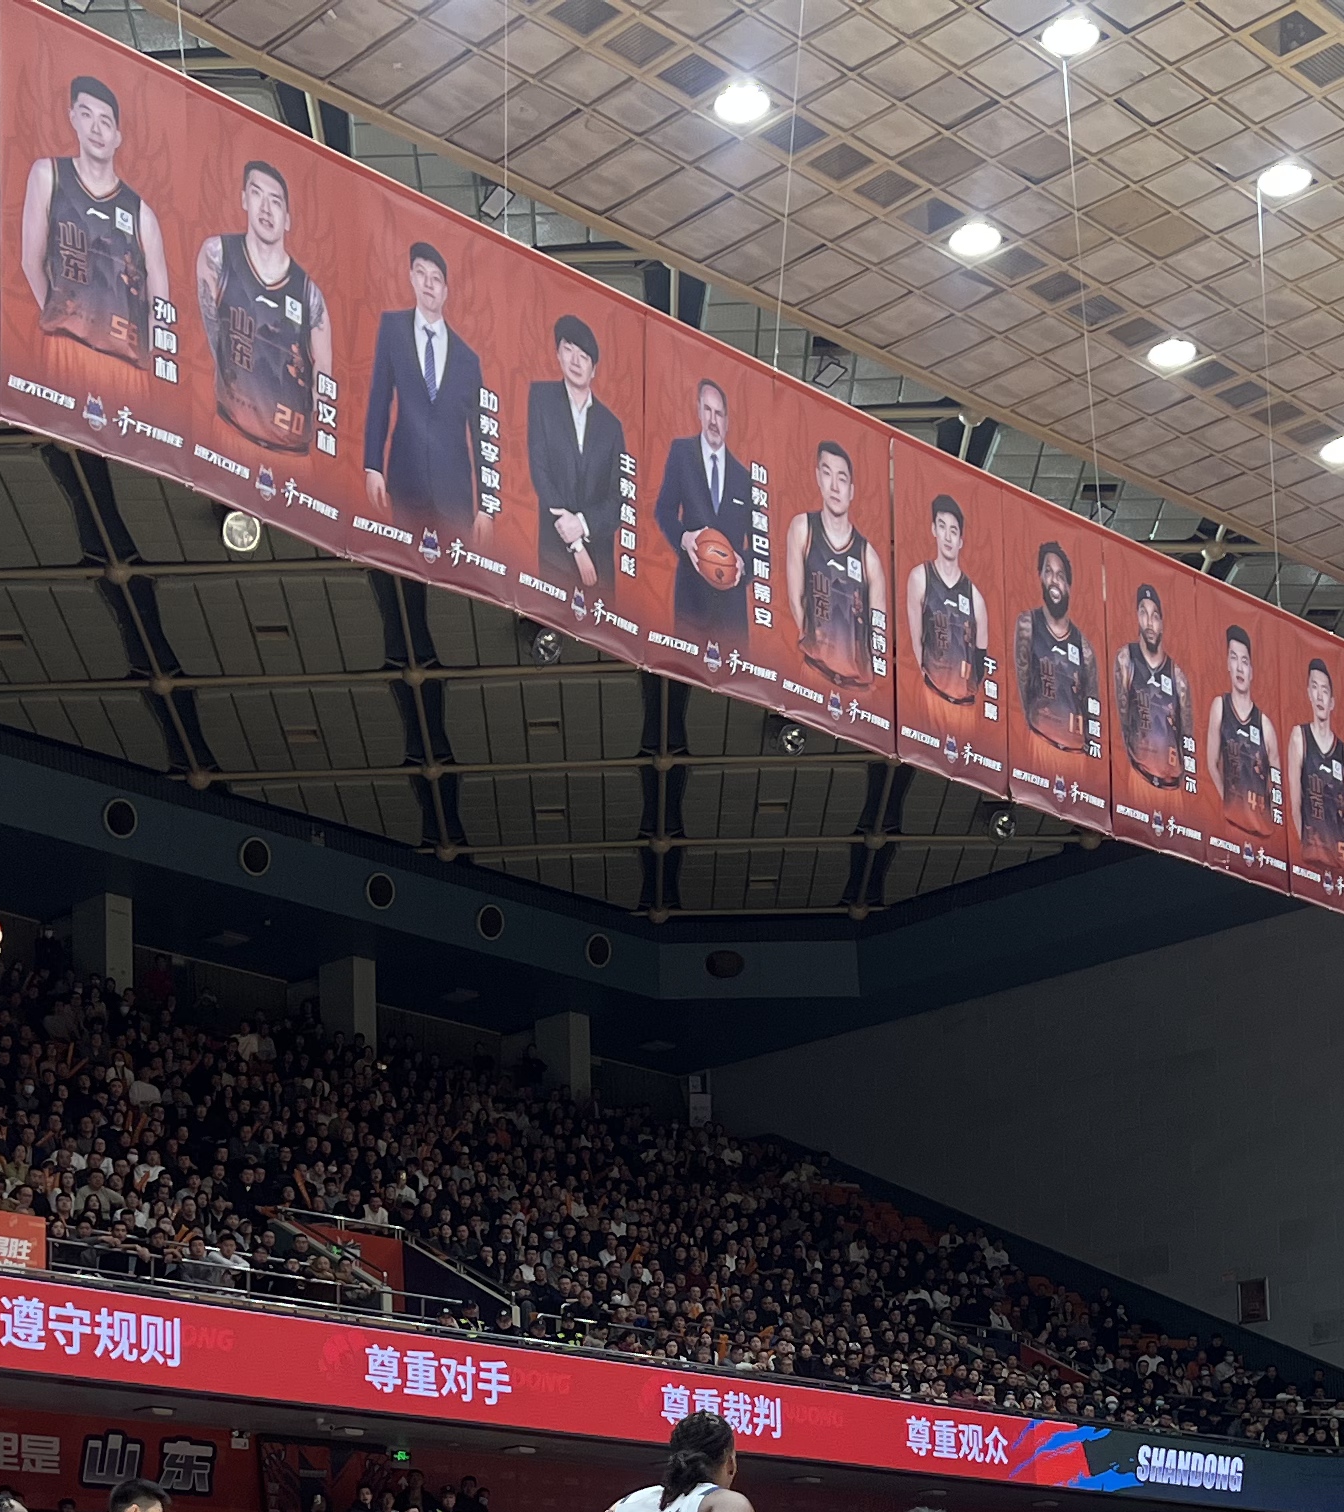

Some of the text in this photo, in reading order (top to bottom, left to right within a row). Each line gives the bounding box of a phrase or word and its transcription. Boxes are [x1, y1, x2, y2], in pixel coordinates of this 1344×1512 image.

[153, 295, 180, 385] 孙桐林
[273, 402, 305, 436] 20
[316, 370, 339, 458] 陶汉林
[619, 451, 639, 580] 主教练邱彪
[363, 1343, 513, 1407] 尊重对手
[659, 1382, 783, 1440] 尊重裁判
[904, 1414, 1010, 1467] 尊重观众
[83, 1432, 216, 1493] 山东
[1135, 1443, 1244, 1493] SHANDONG
